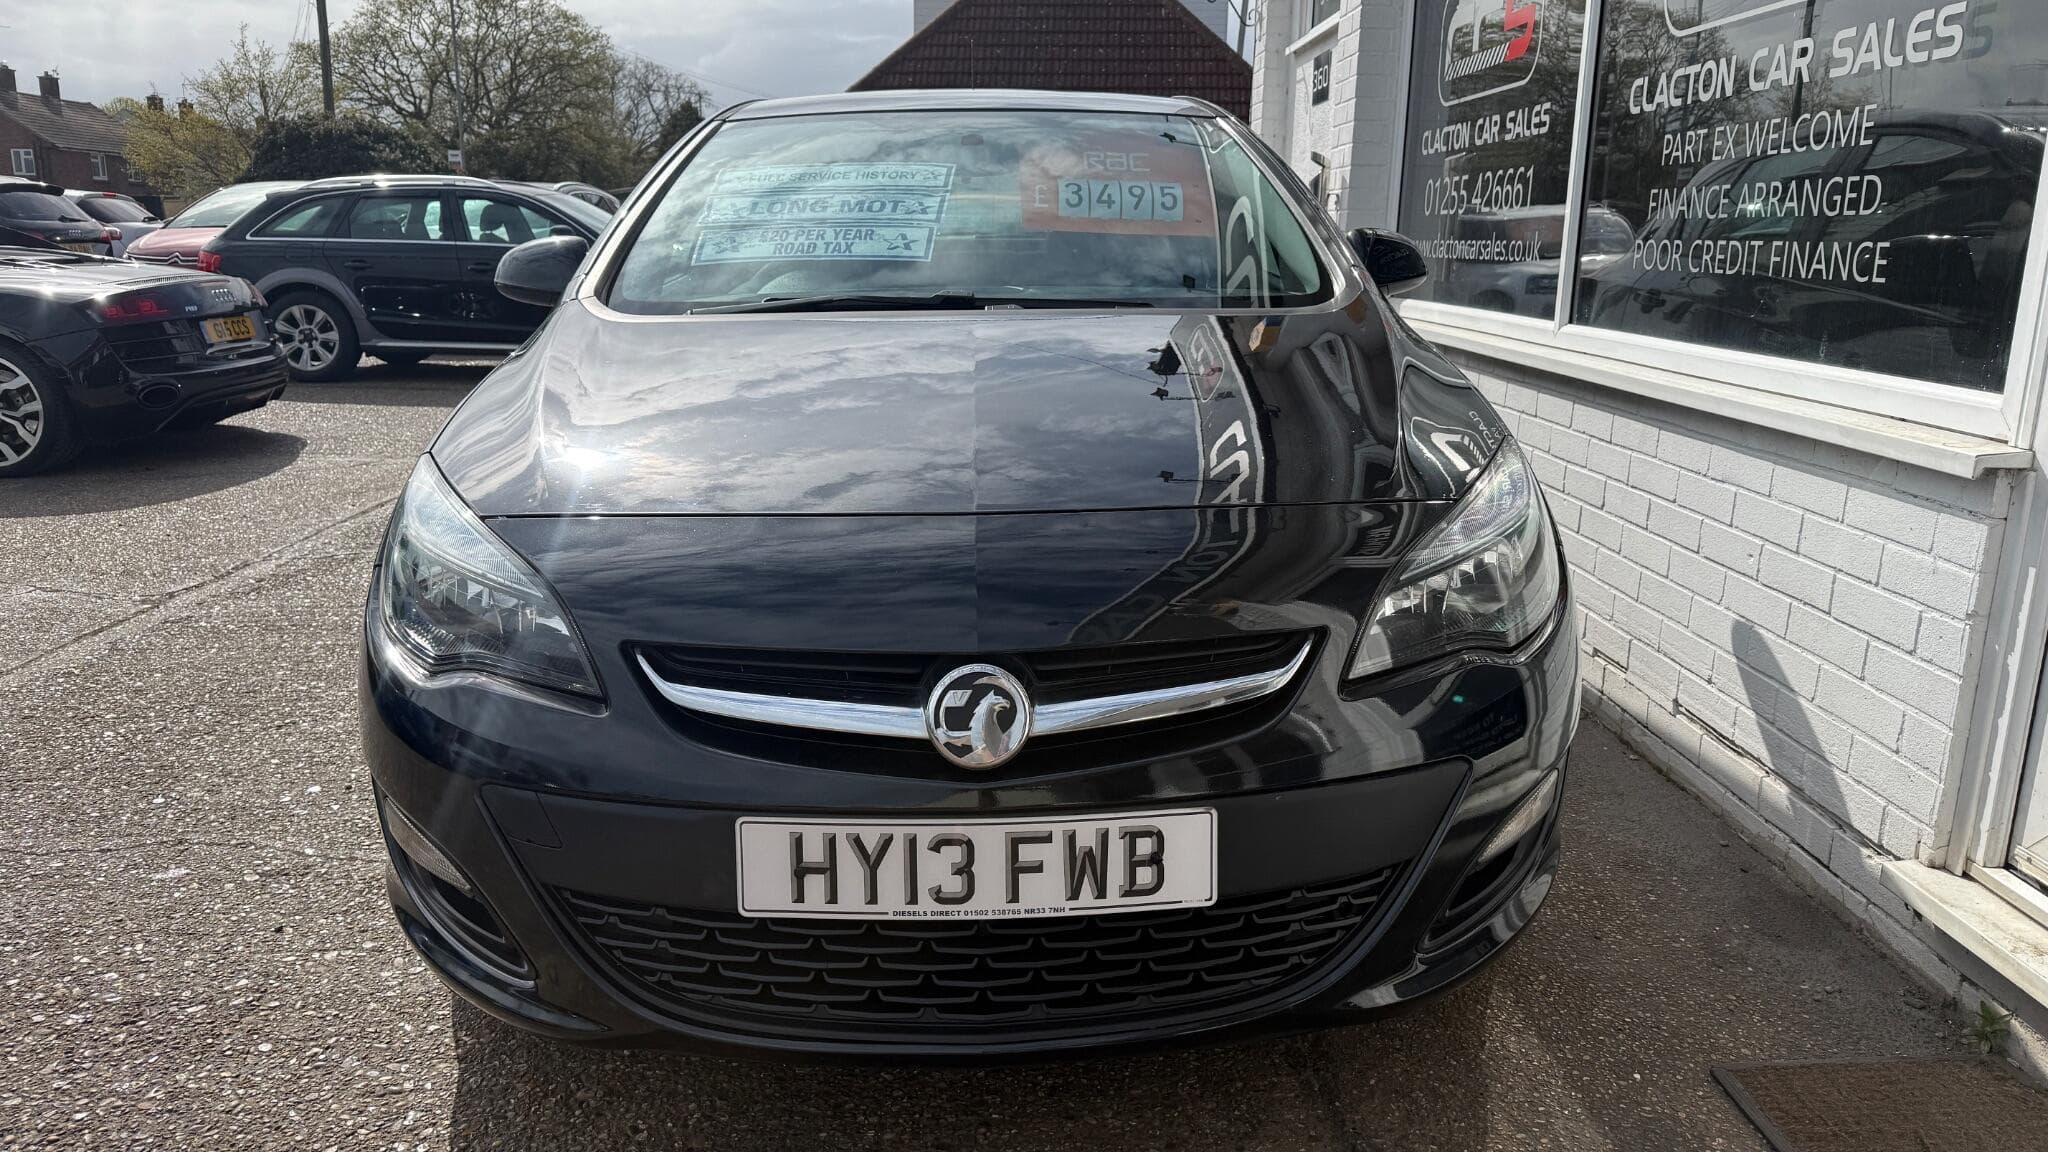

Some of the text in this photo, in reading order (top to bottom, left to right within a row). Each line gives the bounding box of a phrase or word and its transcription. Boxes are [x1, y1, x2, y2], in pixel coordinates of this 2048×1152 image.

[1313, 65, 1329, 93] 360
[1629, 1, 1968, 115] CLACTON CAR SALES
[1421, 102, 1552, 156] CLACTON CAR SALES
[1661, 104, 1878, 167] PART EX WELCOME
[789, 171, 851, 183] SERVICE
[855, 171, 919, 181] HISTORY
[1065, 182, 1178, 211] 3495
[1424, 164, 1535, 217] 01255 426661
[1647, 175, 1882, 221] FINANCE ARRANGED
[750, 200, 906, 215] LONG MOT
[773, 241, 854, 255] ROAD TAX
[794, 229, 827, 241] PER
[833, 228, 875, 241] YEAR
[1633, 239, 1891, 284] POOR CREDIT FINANCE
[788, 825, 1165, 906] HY13 FWB
